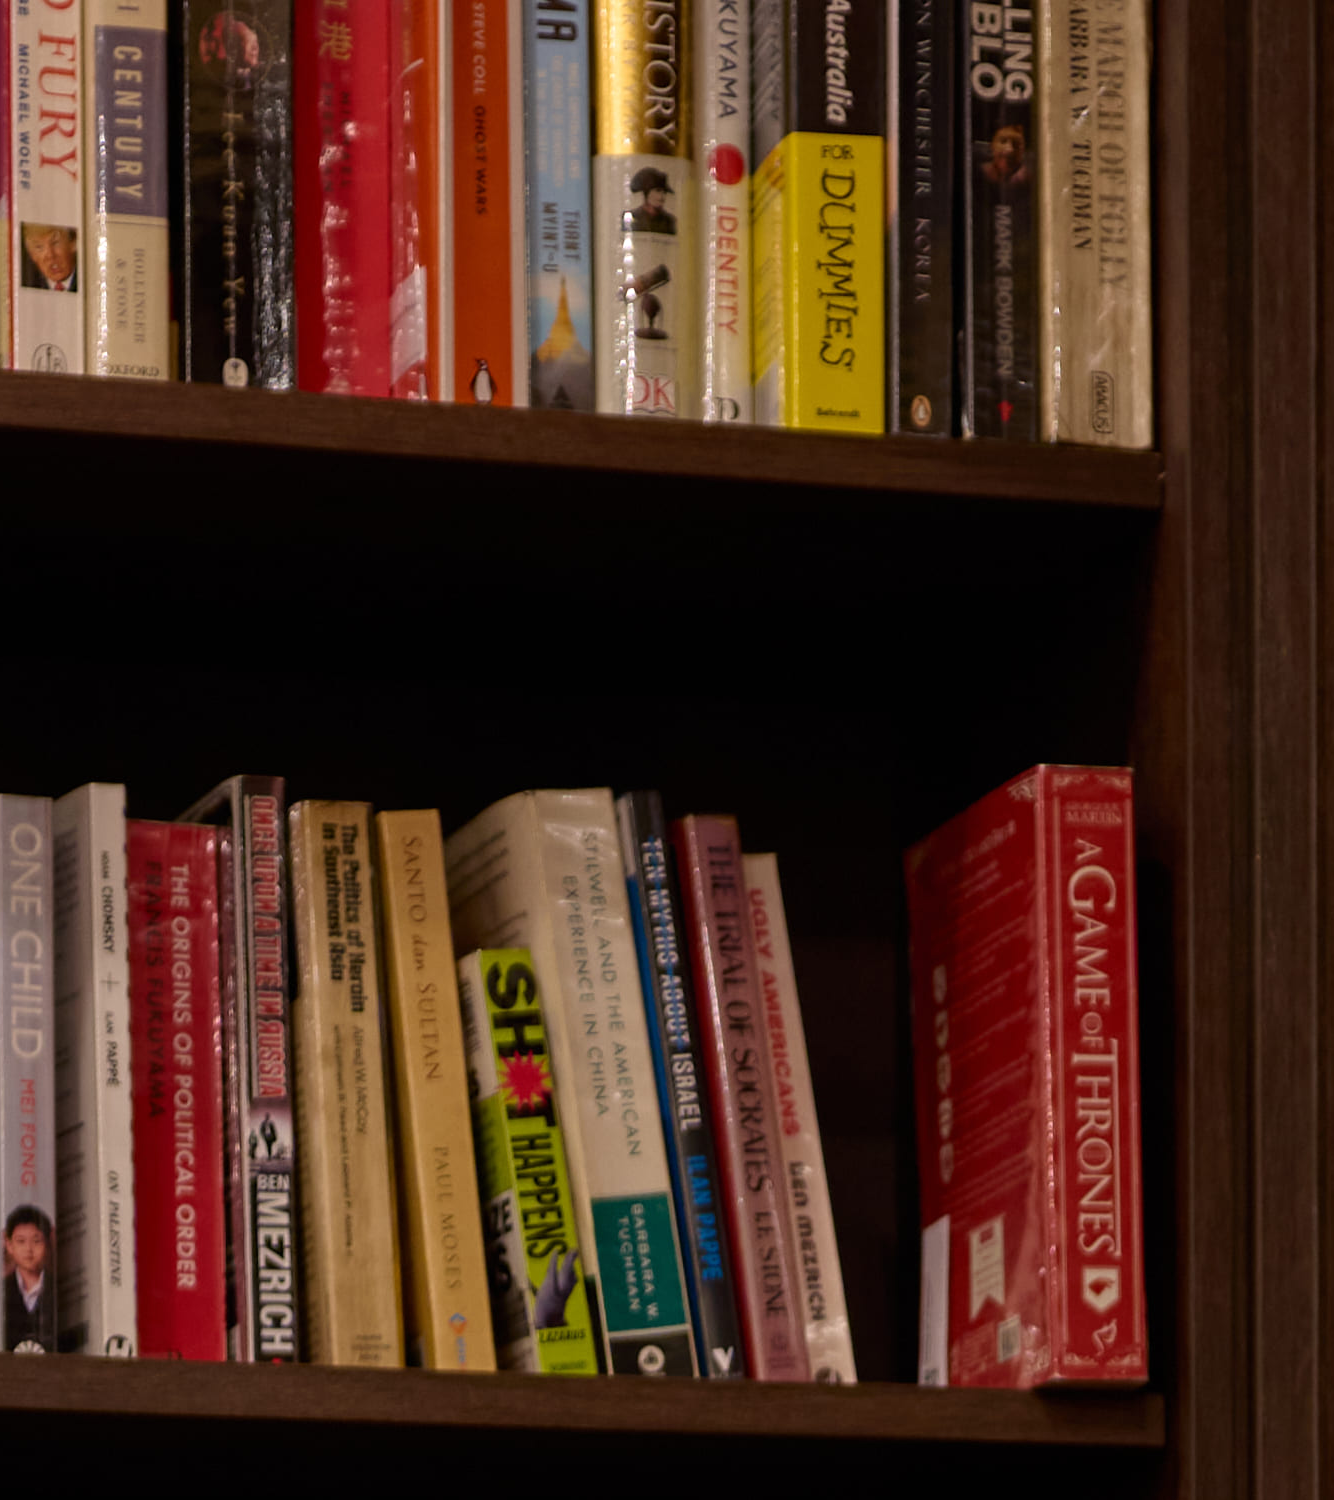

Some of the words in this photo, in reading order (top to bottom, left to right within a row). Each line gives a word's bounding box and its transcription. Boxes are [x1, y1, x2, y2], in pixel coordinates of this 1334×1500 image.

[37, 33, 79, 183] FURY
[112, 45, 146, 199] CENTURY
[716, 206, 739, 336] IDENTITY
[816, 169, 859, 371] DUMMIES
[8, 823, 42, 914] ONE
[169, 863, 190, 907] THE
[1074, 839, 1097, 862] A
[9, 929, 43, 1057] CHILD
[170, 915, 193, 1023] ORIGINS
[1068, 865, 1117, 1006] GAME
[173, 1032, 194, 1062] OF
[1080, 1011, 1103, 1048] OF
[173, 1074, 196, 1195] POLITICAL
[509, 1134, 569, 1261] HAPPENS
[1072, 1039, 1119, 1254] THRONES
[175, 1204, 198, 1287] ORDER
[255, 1189, 294, 1350] MEZRICH
